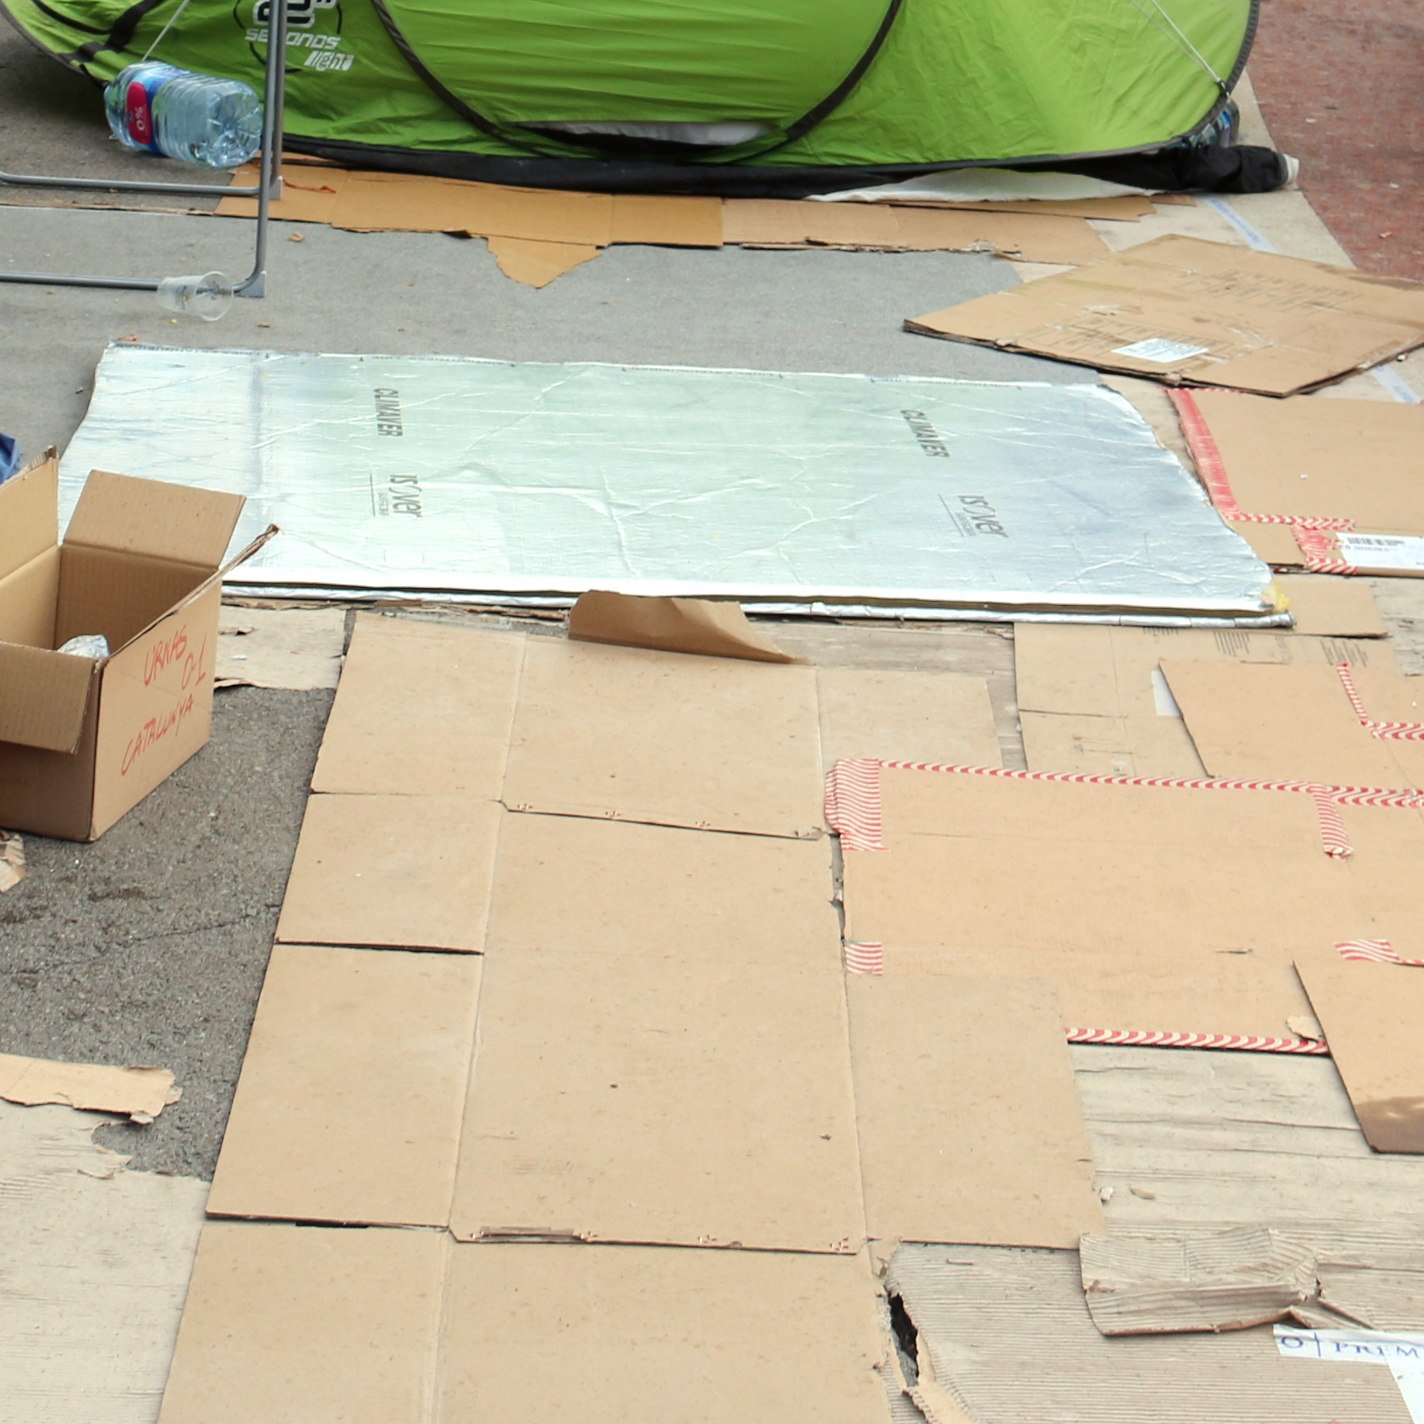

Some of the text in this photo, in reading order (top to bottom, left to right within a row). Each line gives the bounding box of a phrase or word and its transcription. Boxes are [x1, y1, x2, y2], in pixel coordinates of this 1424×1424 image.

[373, 387, 404, 437] CLIMAVER
[899, 410, 951, 458] CLIMAVER
[121, 693, 194, 776] CATALUNYA
